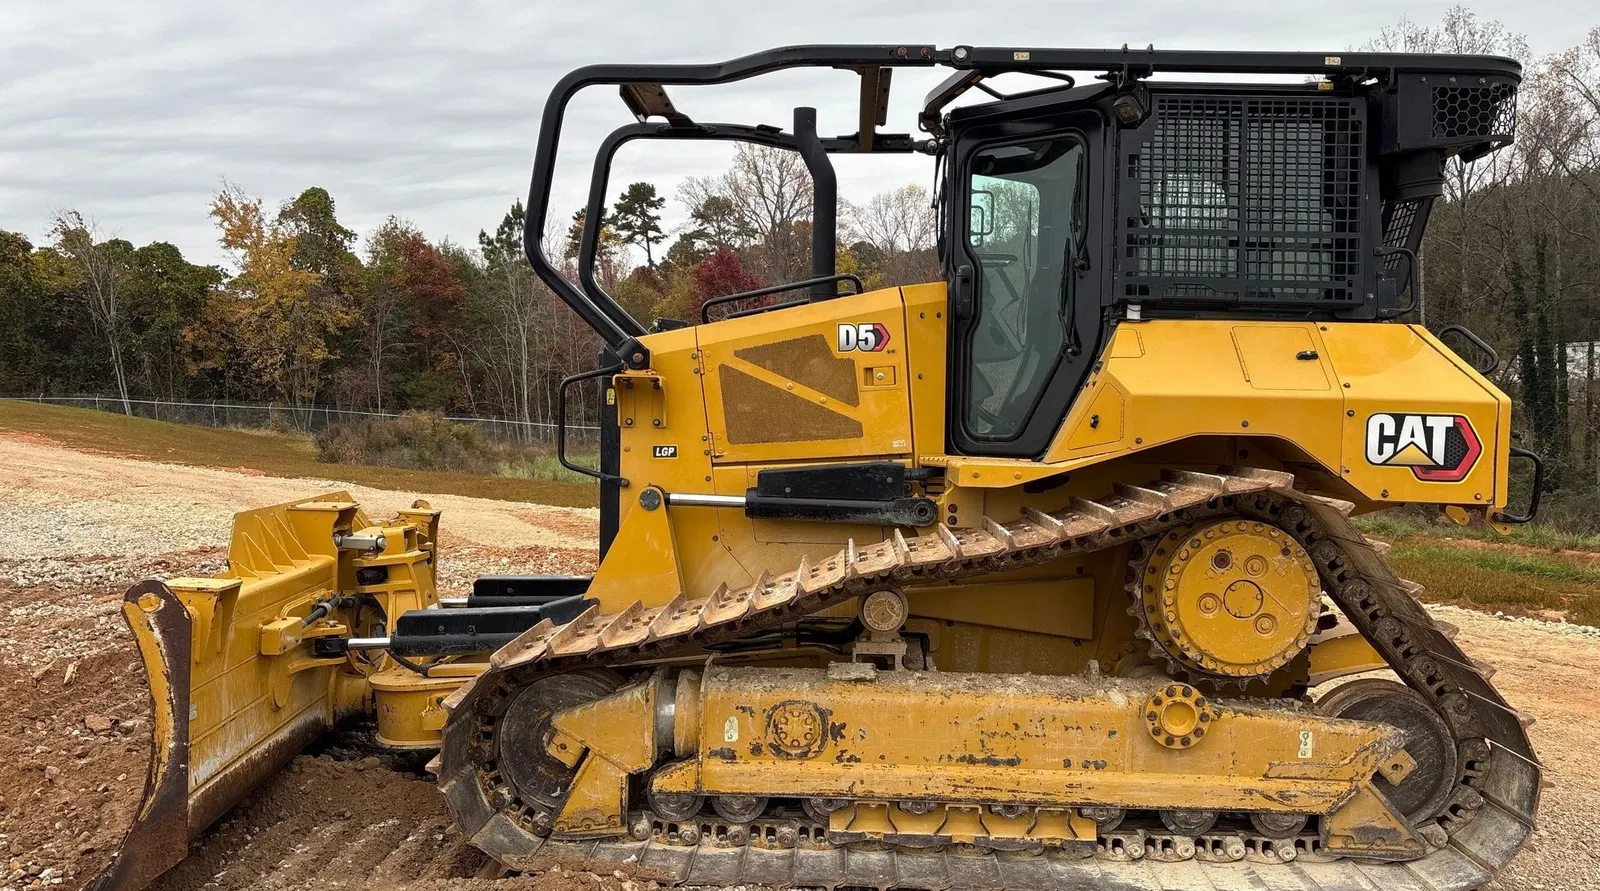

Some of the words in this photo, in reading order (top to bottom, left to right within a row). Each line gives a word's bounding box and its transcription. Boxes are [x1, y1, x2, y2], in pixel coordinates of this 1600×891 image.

[838, 324, 876, 351] D5
[655, 447, 675, 457] LGP
[1366, 413, 1454, 466] CAT
